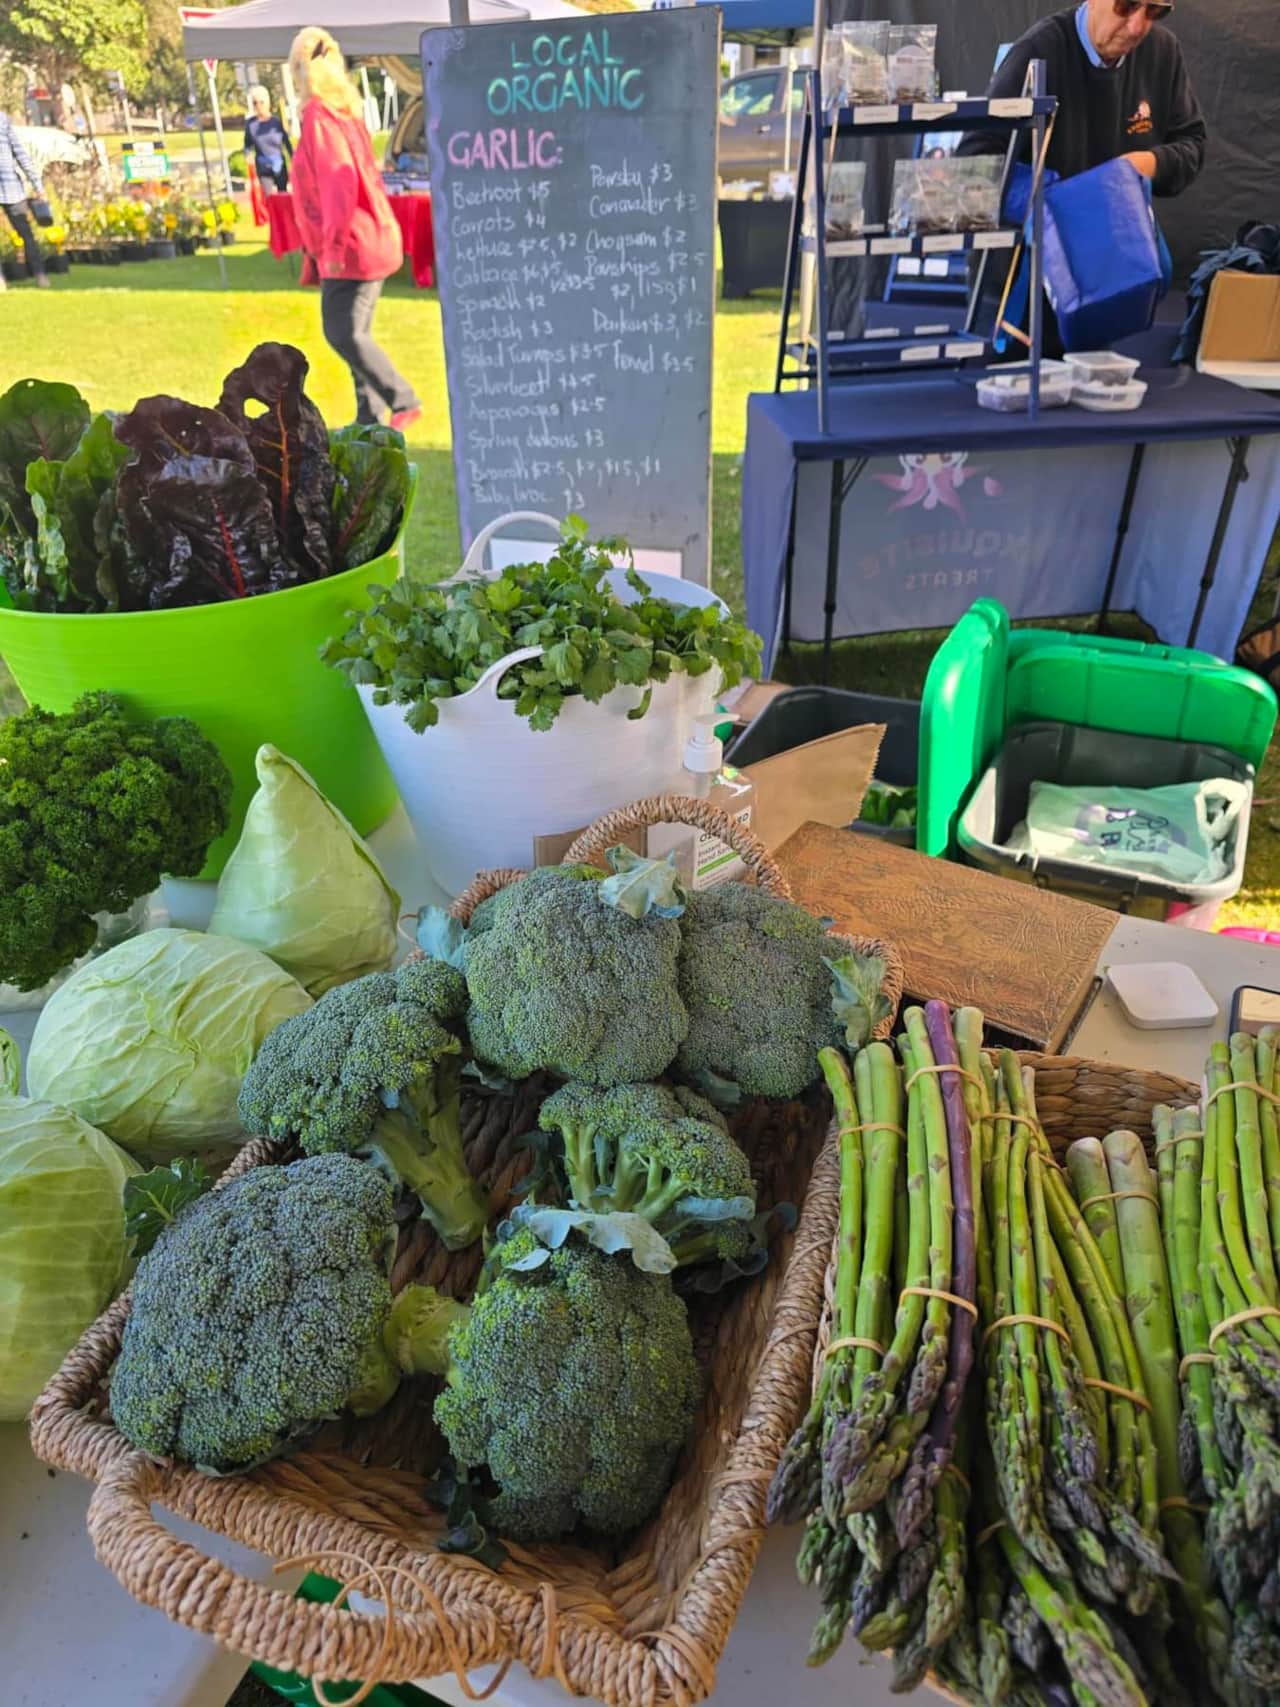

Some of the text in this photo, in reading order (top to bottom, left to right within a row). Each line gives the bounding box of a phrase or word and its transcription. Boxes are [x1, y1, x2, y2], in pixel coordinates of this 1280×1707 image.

[511, 28, 624, 68] LOCAL
[487, 67, 645, 116] ORGANIC
[650, 162, 673, 184] $3
[452, 178, 552, 210] Beetroot $5
[452, 207, 546, 237] Carrots $4
[662, 225, 687, 248] $2
[455, 236, 513, 261] Lettuce
[584, 255, 660, 294] Parsnips
[460, 314, 554, 341] Radish $3
[592, 306, 648, 334] Daikon
[468, 399, 560, 437] Asparagus
[468, 428, 524, 461] Spring
[585, 428, 605, 448] $3
